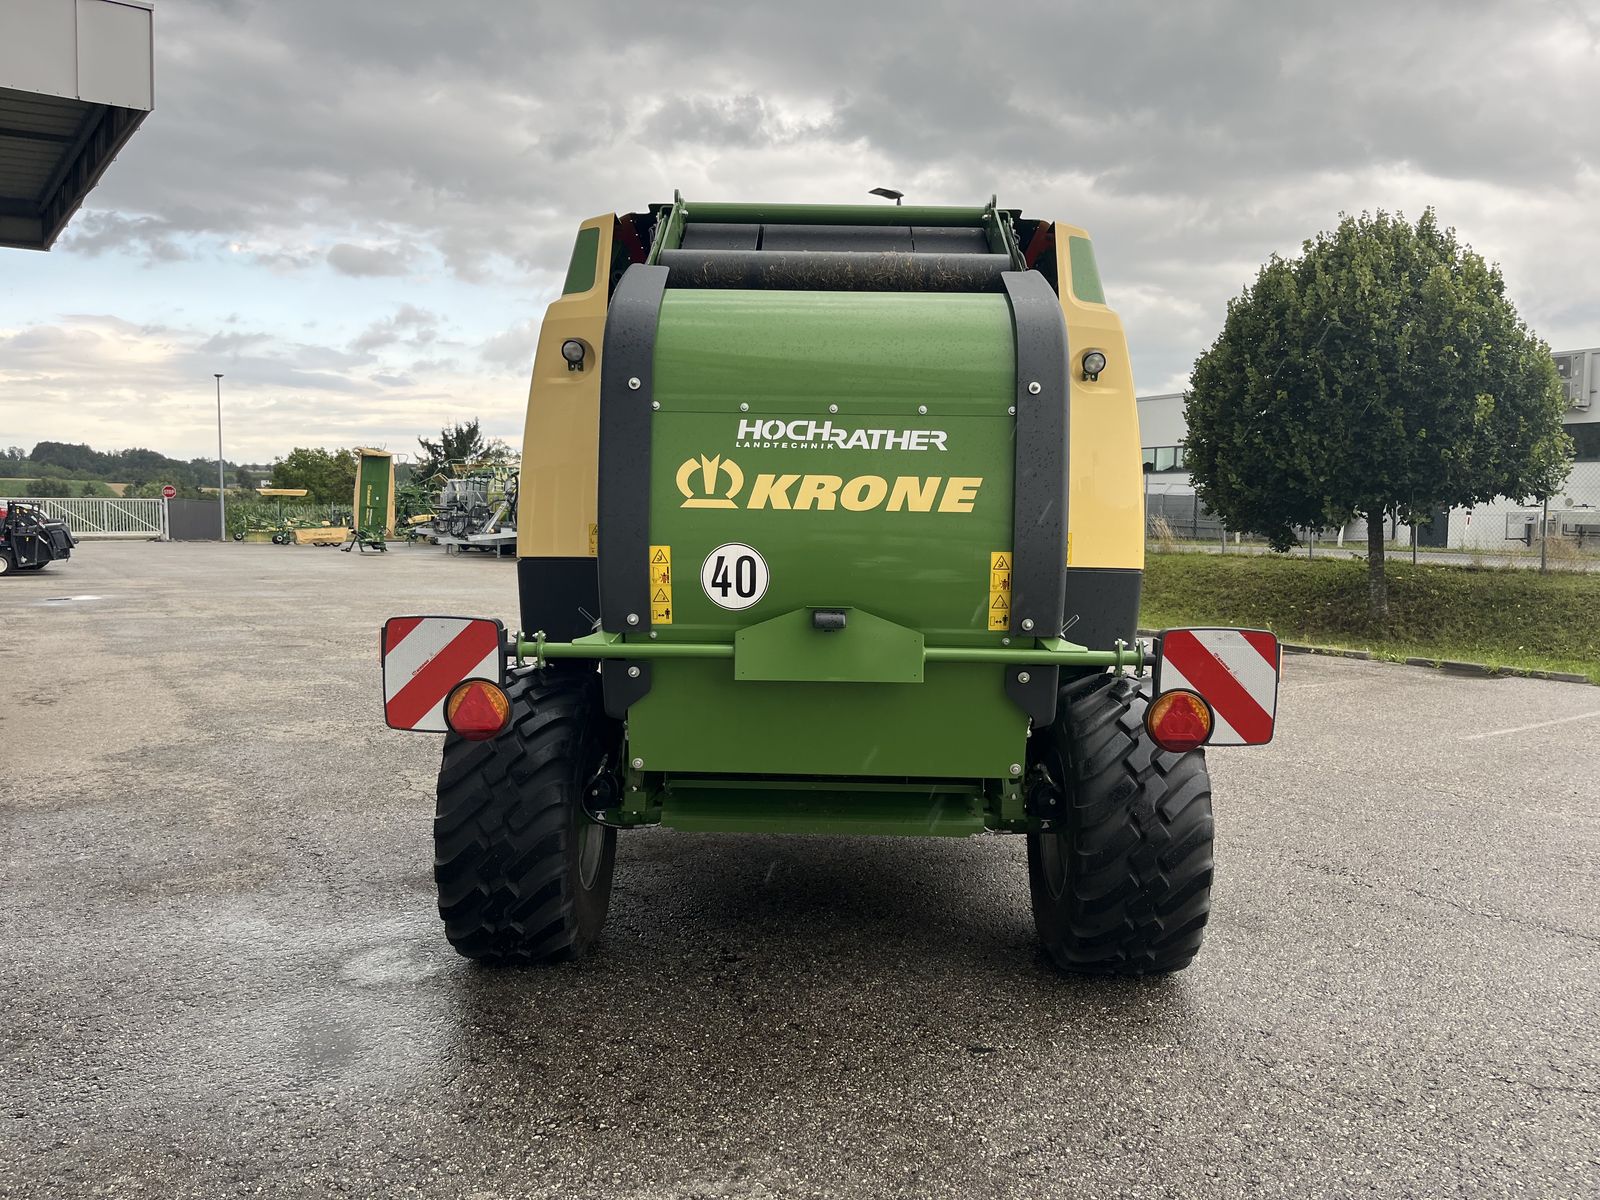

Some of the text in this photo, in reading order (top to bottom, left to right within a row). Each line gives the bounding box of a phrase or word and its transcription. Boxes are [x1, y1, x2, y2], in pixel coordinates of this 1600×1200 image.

[735, 441, 835, 450] LANDTECHNIK
[736, 419, 949, 451] HOCHRATHER
[747, 473, 984, 513] KRONE
[710, 554, 757, 599] 40
